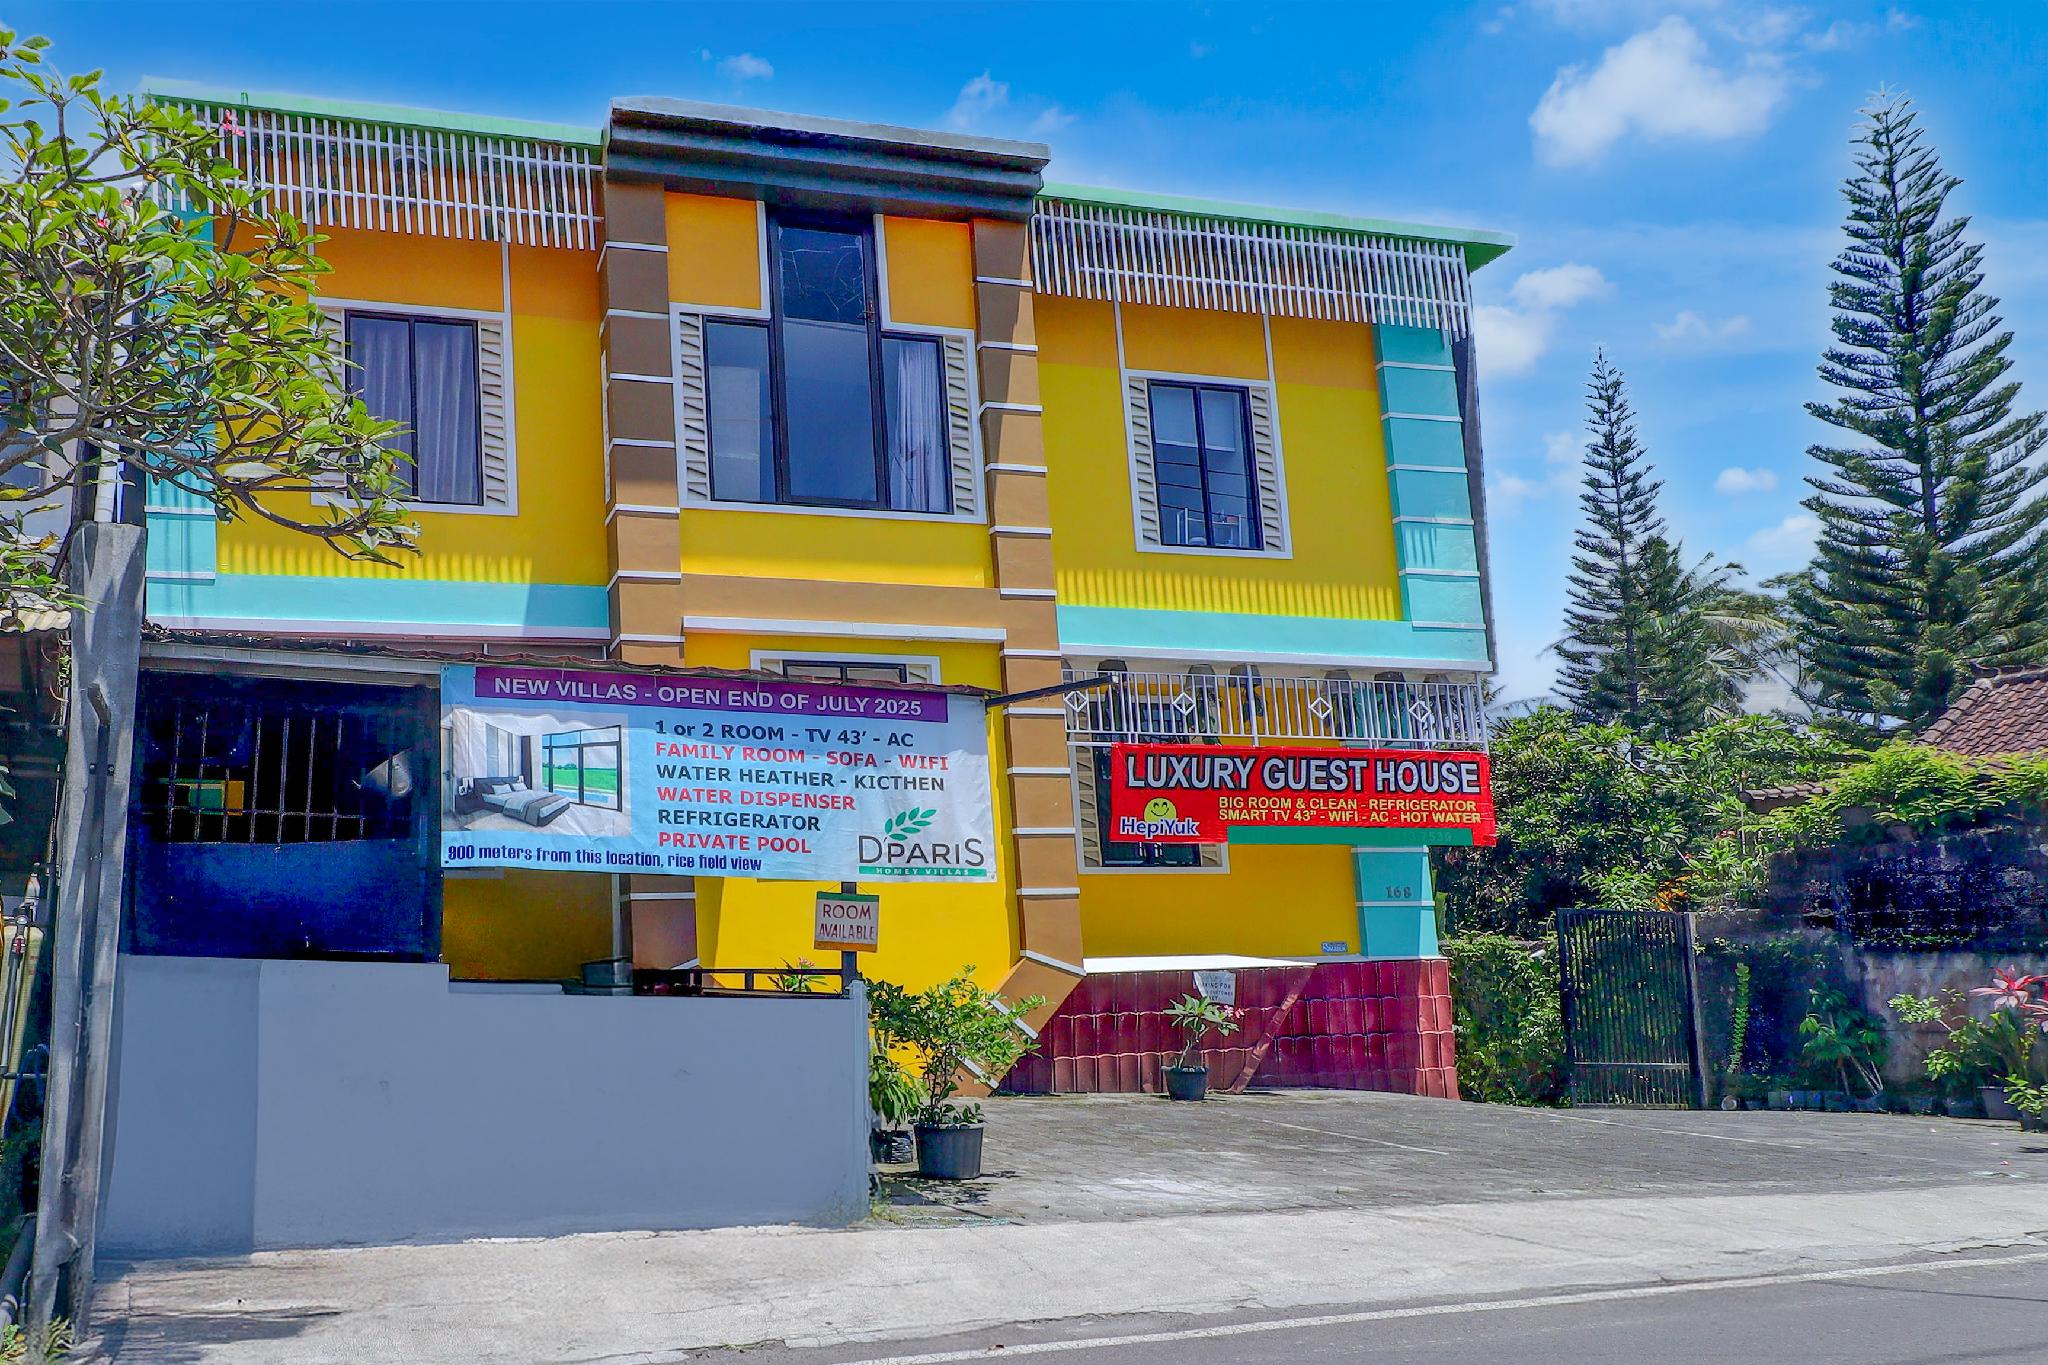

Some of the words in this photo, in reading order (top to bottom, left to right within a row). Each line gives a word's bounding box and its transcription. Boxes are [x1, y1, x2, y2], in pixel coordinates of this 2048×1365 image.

[494, 677, 549, 696] NEW
[556, 680, 637, 700] VILLAS
[658, 686, 720, 705] OPEN
[728, 690, 773, 707] END
[780, 693, 809, 710] OF
[816, 695, 869, 713] JULY
[874, 698, 922, 715] 2025
[655, 720, 667, 734] 1
[673, 724, 696, 736] or
[702, 723, 714, 737] 2
[721, 724, 784, 741] ROOM
[805, 728, 831, 743] TV
[888, 732, 914, 747] AC
[656, 742, 735, 760] FAMILY
[743, 747, 805, 763] ROOM
[827, 751, 877, 768] SOFA
[899, 754, 949, 771] WIFI
[656, 764, 732, 782] WATER
[740, 768, 835, 787] HEATHER
[854, 775, 944, 791] KICTHEN
[1127, 755, 1256, 790] LUXURY
[1262, 757, 1368, 792] GUEST
[1375, 760, 1481, 793] HOUSE
[657, 786, 733, 804] WATER
[740, 789, 856, 810] DISPENSER
[1219, 796, 1244, 808] BIG
[1248, 797, 1291, 809] ROOM
[1295, 797, 1305, 809] &
[1310, 798, 1357, 810] CLEAN
[1369, 799, 1477, 811] REFRIGERATOR
[658, 809, 822, 831] REFRIGERATOR
[1121, 817, 1198, 838] HepiYuk
[1219, 809, 1268, 821] SMART
[1273, 810, 1290, 821] TV
[1329, 811, 1358, 822] WIFI
[1370, 811, 1389, 822] AC
[1401, 811, 1429, 823] HOT
[1433, 812, 1481, 824] WATER
[658, 831, 750, 850] PRIVATE
[757, 836, 812, 854] POOL
[448, 844, 475, 860] 900
[479, 845, 532, 861] meters
[536, 847, 571, 863] from
[576, 849, 601, 864] this
[606, 850, 664, 868] location,
[668, 853, 695, 868] rice
[699, 854, 727, 870] field
[731, 857, 762, 871] view
[876, 867, 918, 875] HOMEY
[925, 868, 969, 876] VILLAS
[823, 903, 871, 920] ROOM
[819, 923, 876, 941] AVAILABLE
